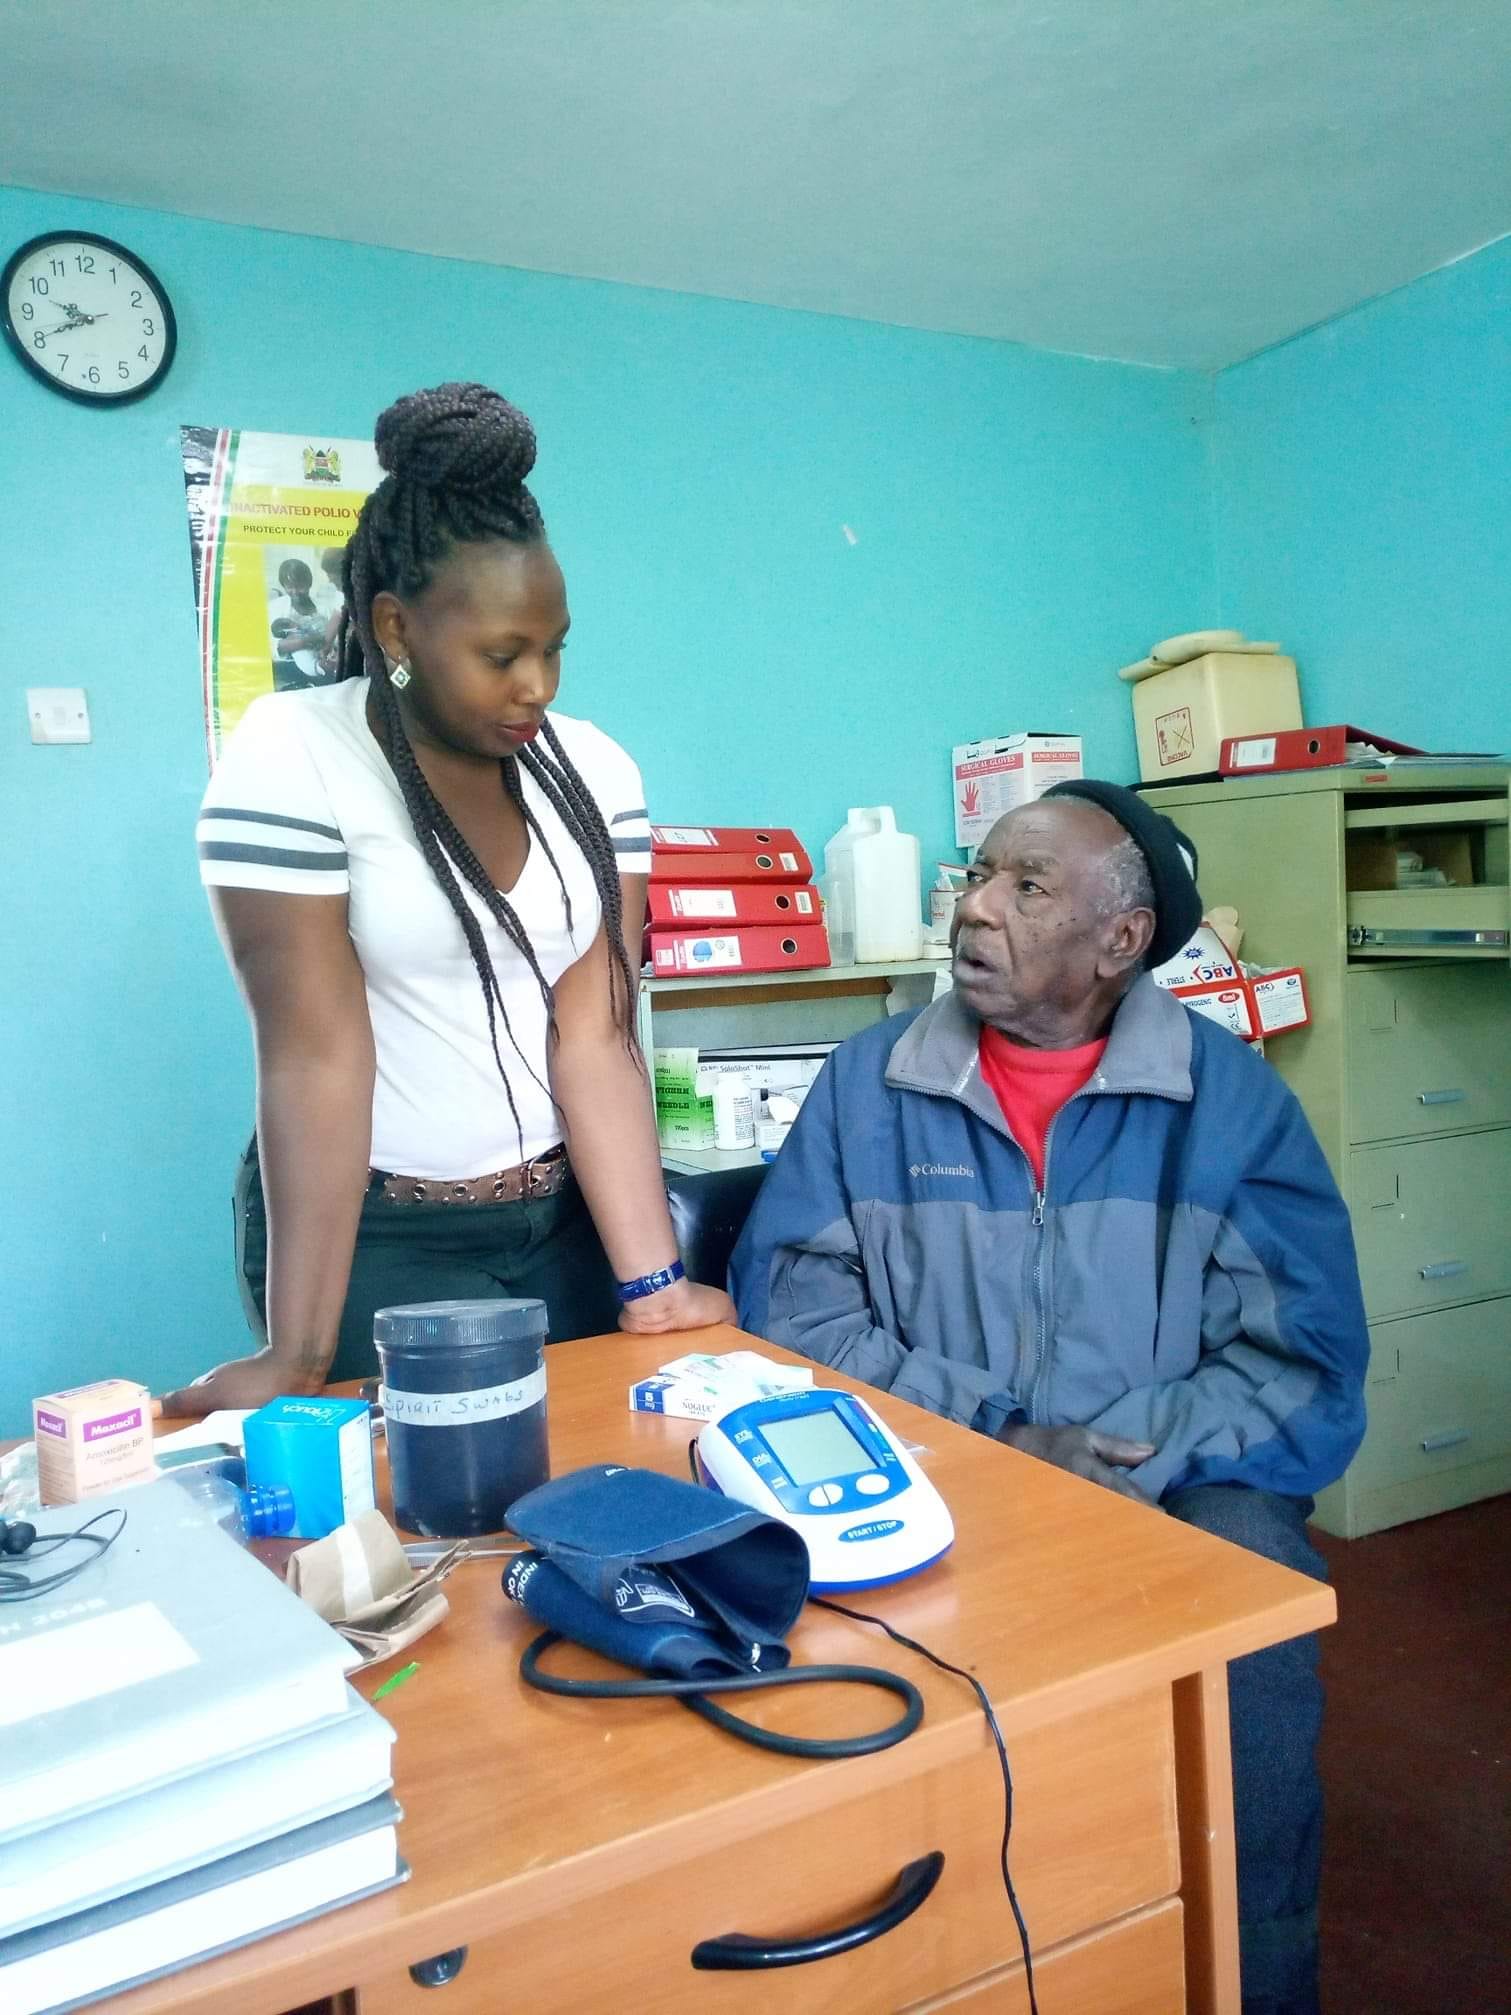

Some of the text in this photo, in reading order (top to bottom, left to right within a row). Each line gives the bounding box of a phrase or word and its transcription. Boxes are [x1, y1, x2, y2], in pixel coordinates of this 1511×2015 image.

[50, 258, 64, 277] 11
[75, 255, 95, 275] 12
[108, 267, 117, 285] 1
[29, 276, 49, 295] 10
[130, 290, 143, 309] 2
[21, 302, 34, 320] 9
[142, 318, 154, 336] 3
[34, 330, 46, 349] 8
[137, 344, 149, 361] 4
[57, 353, 69, 372] 7
[118, 360, 130, 379] 5
[88, 366, 101, 384] 6
[313, 506, 350, 518] POLIO
[243, 525, 288, 535] PROTECT
[289, 527, 315, 536] YOUR
[317, 528, 345, 537] CHILD
[990, 755, 1016, 766] GLOVES
[1203, 965, 1233, 980] ABC
[921, 1163, 975, 1178] Columbia
